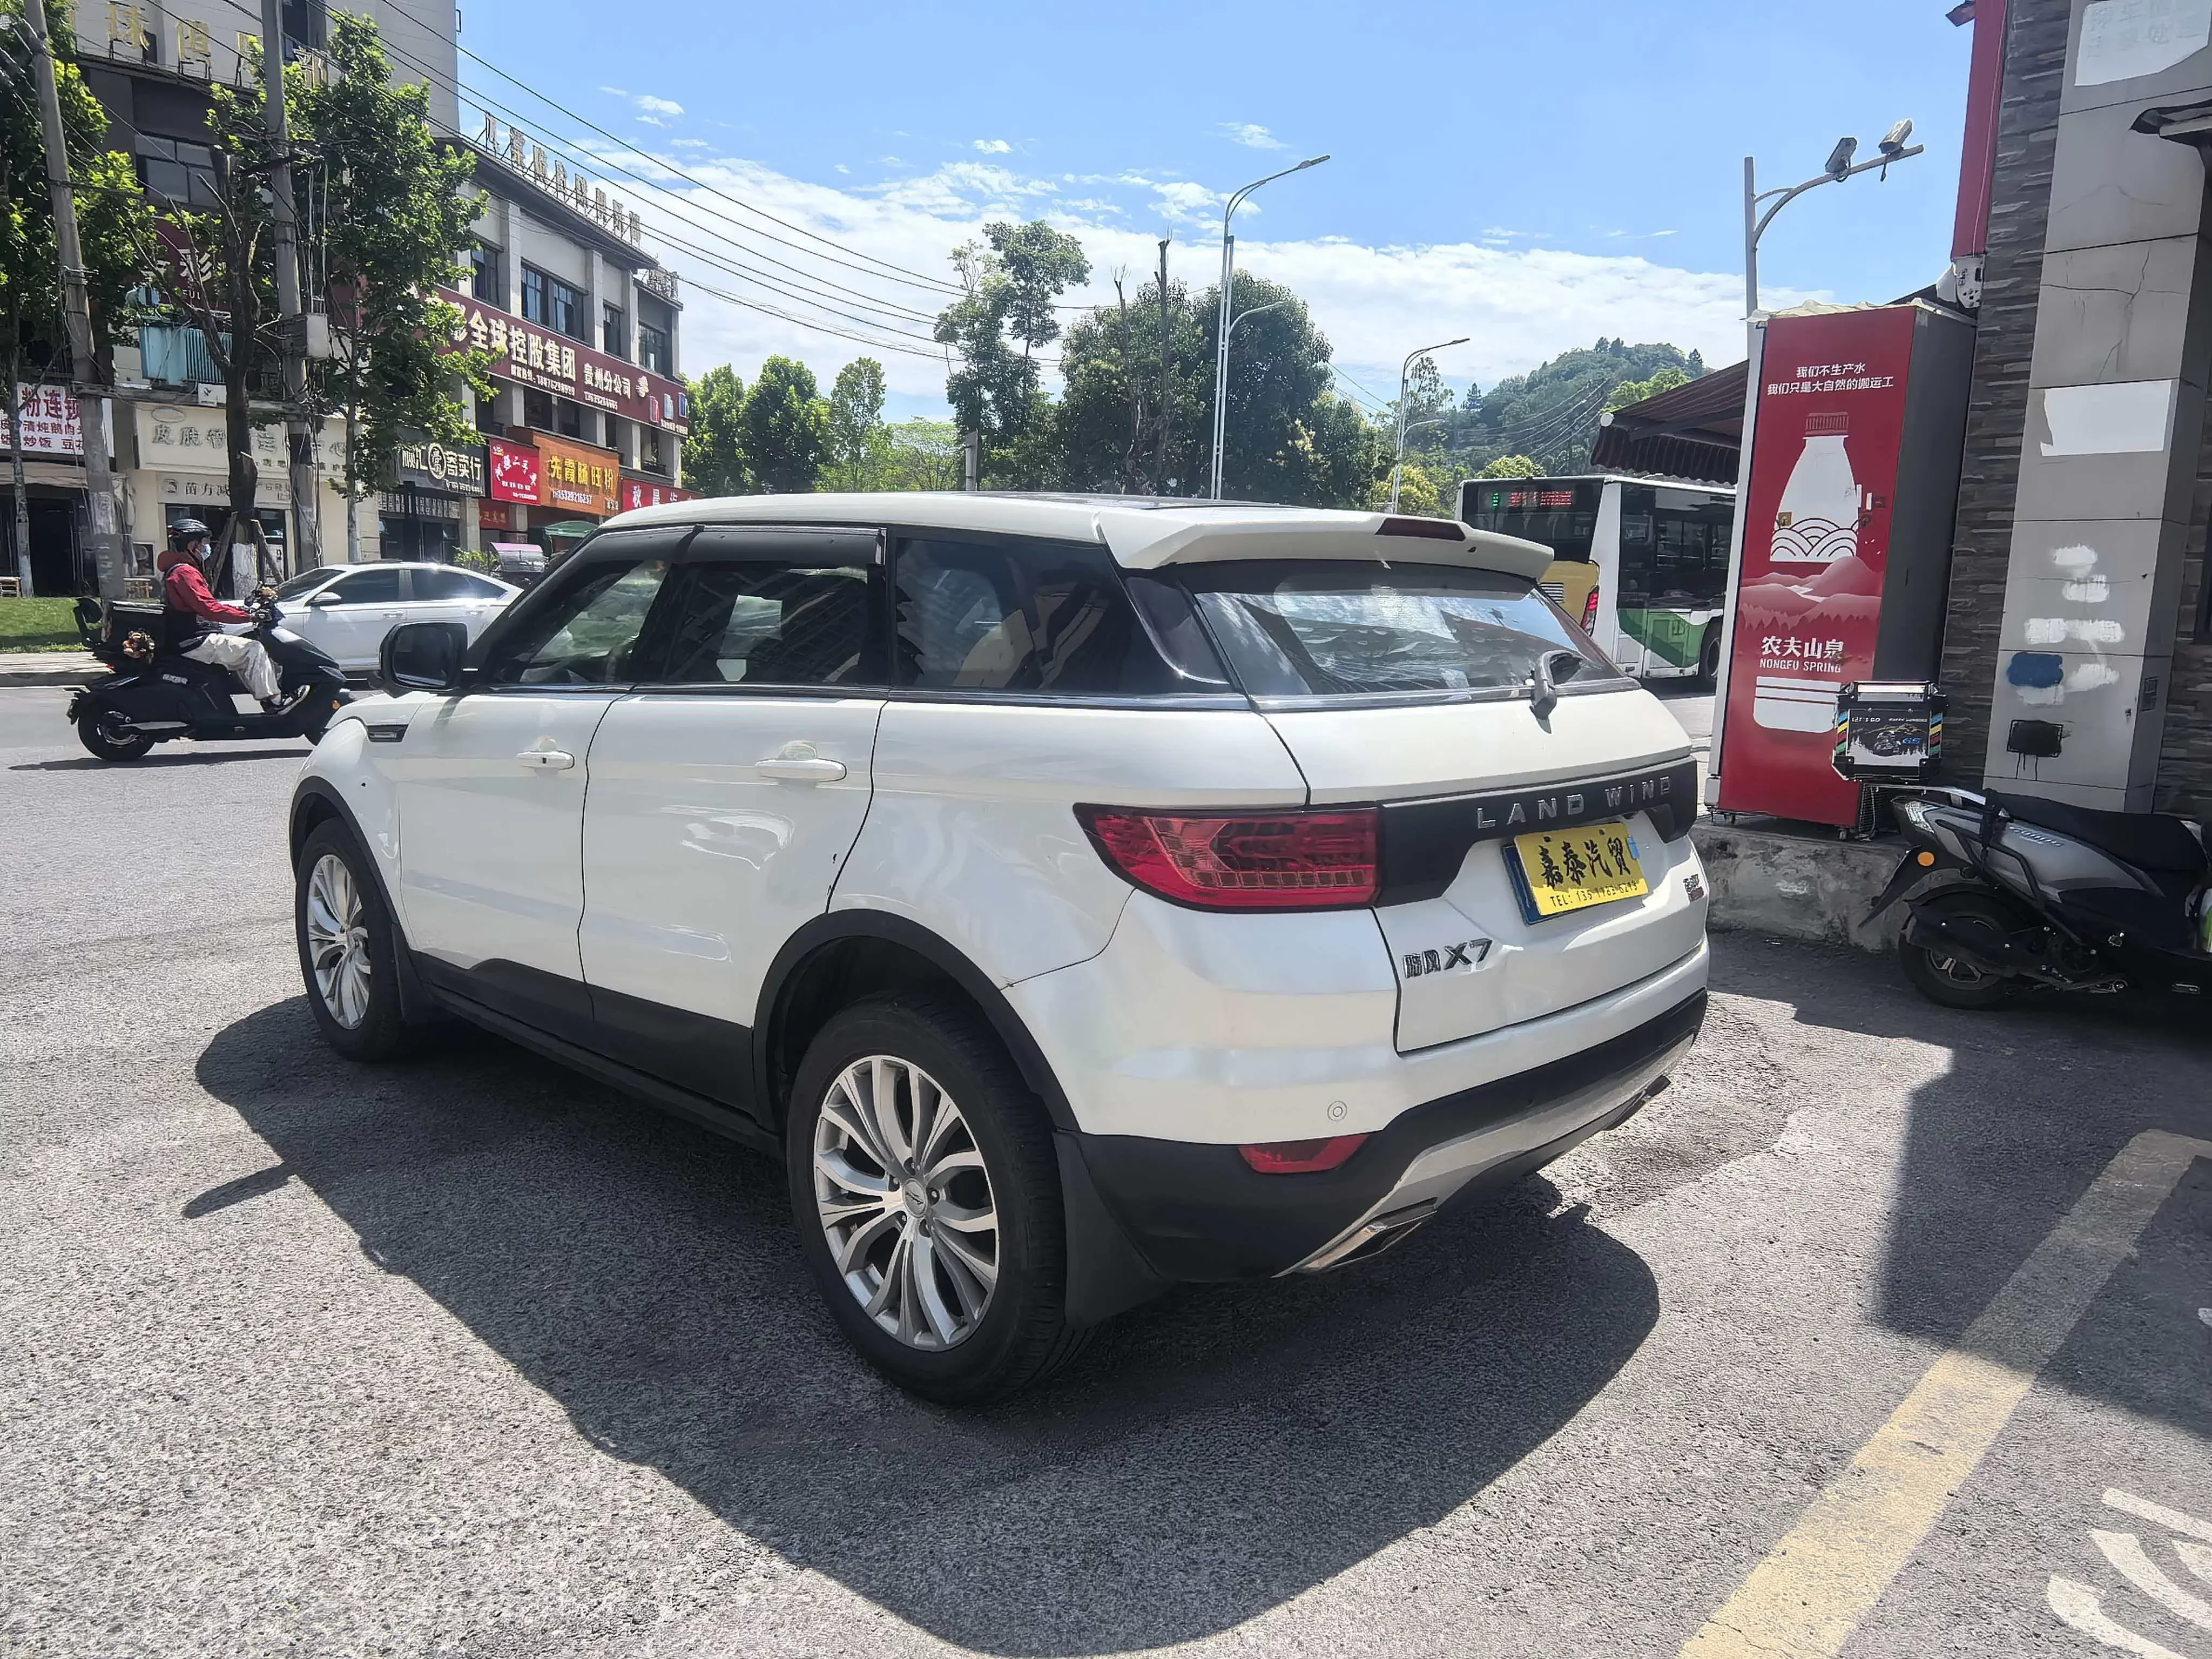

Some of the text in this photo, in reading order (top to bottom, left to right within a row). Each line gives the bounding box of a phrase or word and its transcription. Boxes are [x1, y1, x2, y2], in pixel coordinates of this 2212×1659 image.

[1796, 362, 1866, 378] 我们不生产水
[584, 362, 631, 399] 贵州分公司
[1767, 376, 1894, 395] 我们只是大自然的搬运工
[1761, 636, 1844, 659] 农夫山泉
[1759, 658, 1799, 670] NONGFU
[1476, 776, 1671, 830] LAND WIND
[1550, 894, 1573, 907] TEL:
[1576, 889, 1593, 901] 135
